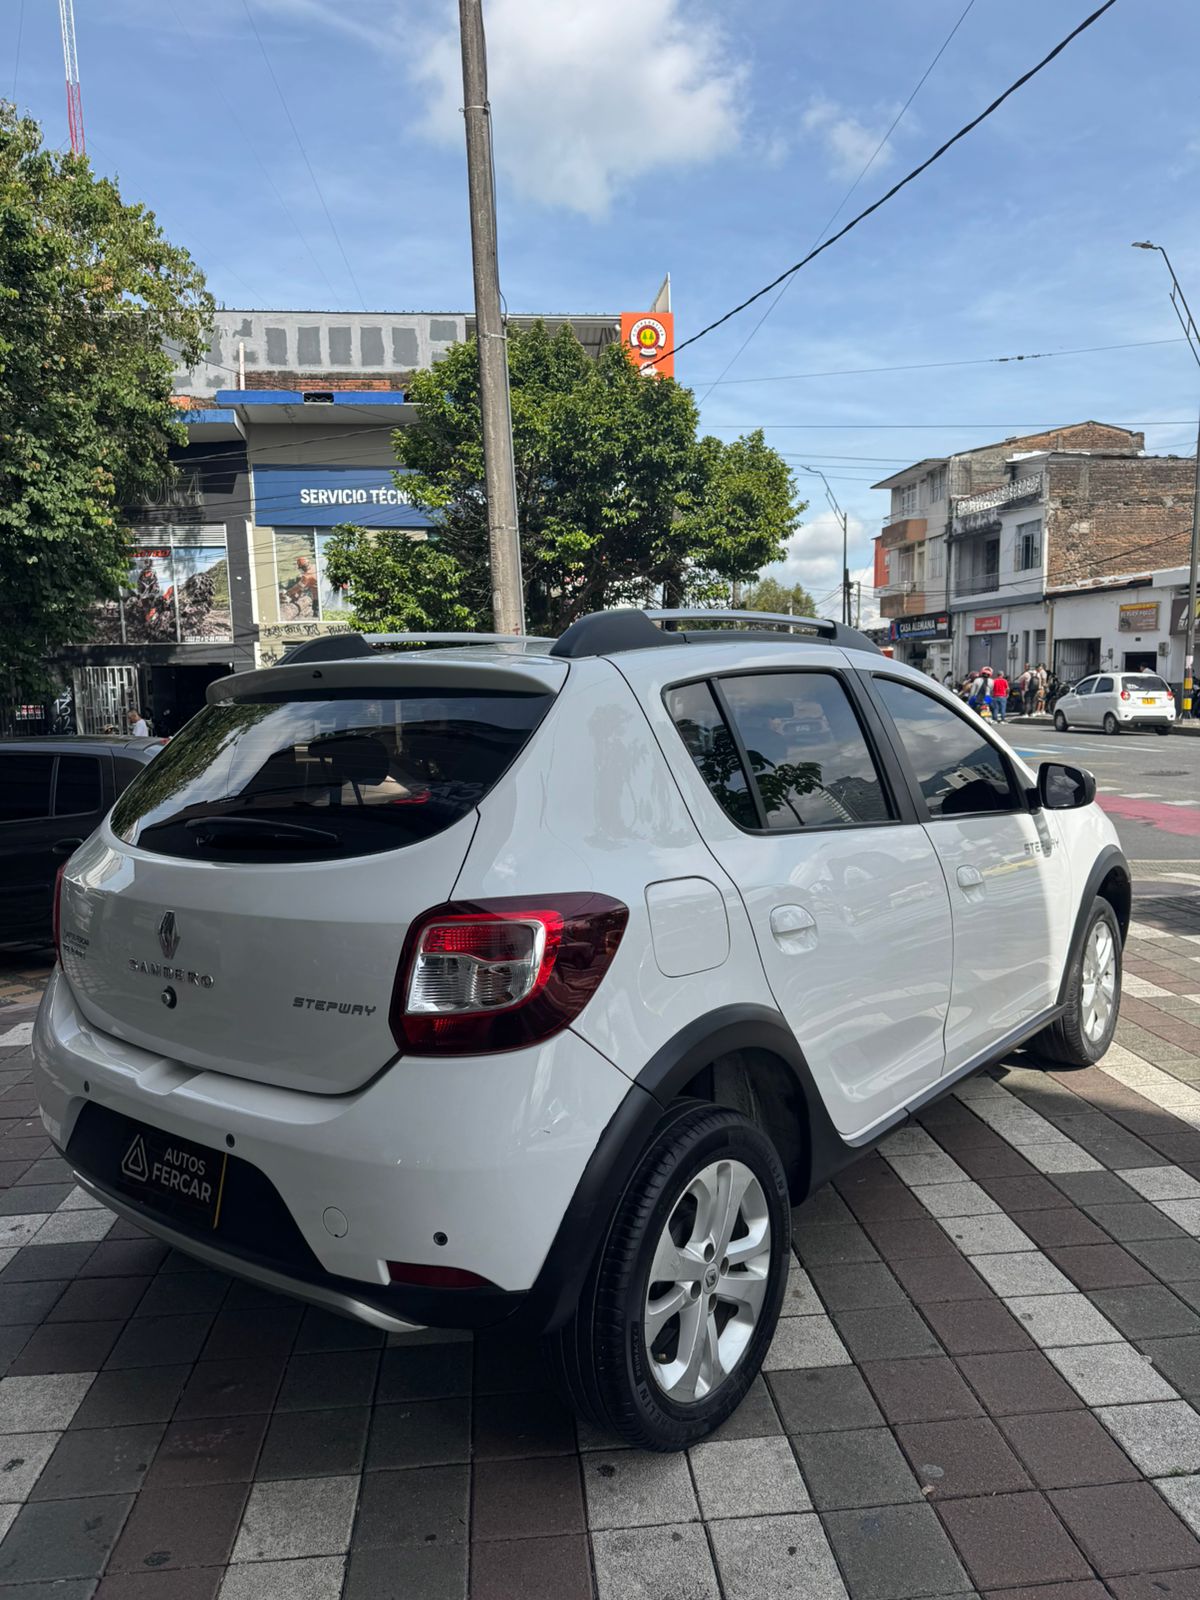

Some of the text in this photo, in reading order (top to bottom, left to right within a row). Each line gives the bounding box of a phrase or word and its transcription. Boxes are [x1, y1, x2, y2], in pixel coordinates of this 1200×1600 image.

[301, 488, 367, 504] SERVICIO
[900, 622, 911, 633] CASA
[912, 619, 935, 631] ALEMANA
[128, 957, 215, 990] SANDERO
[292, 996, 377, 1017] STEPWAY
[163, 1147, 207, 1176] AUTOS
[152, 1162, 212, 1204] FERCAR
